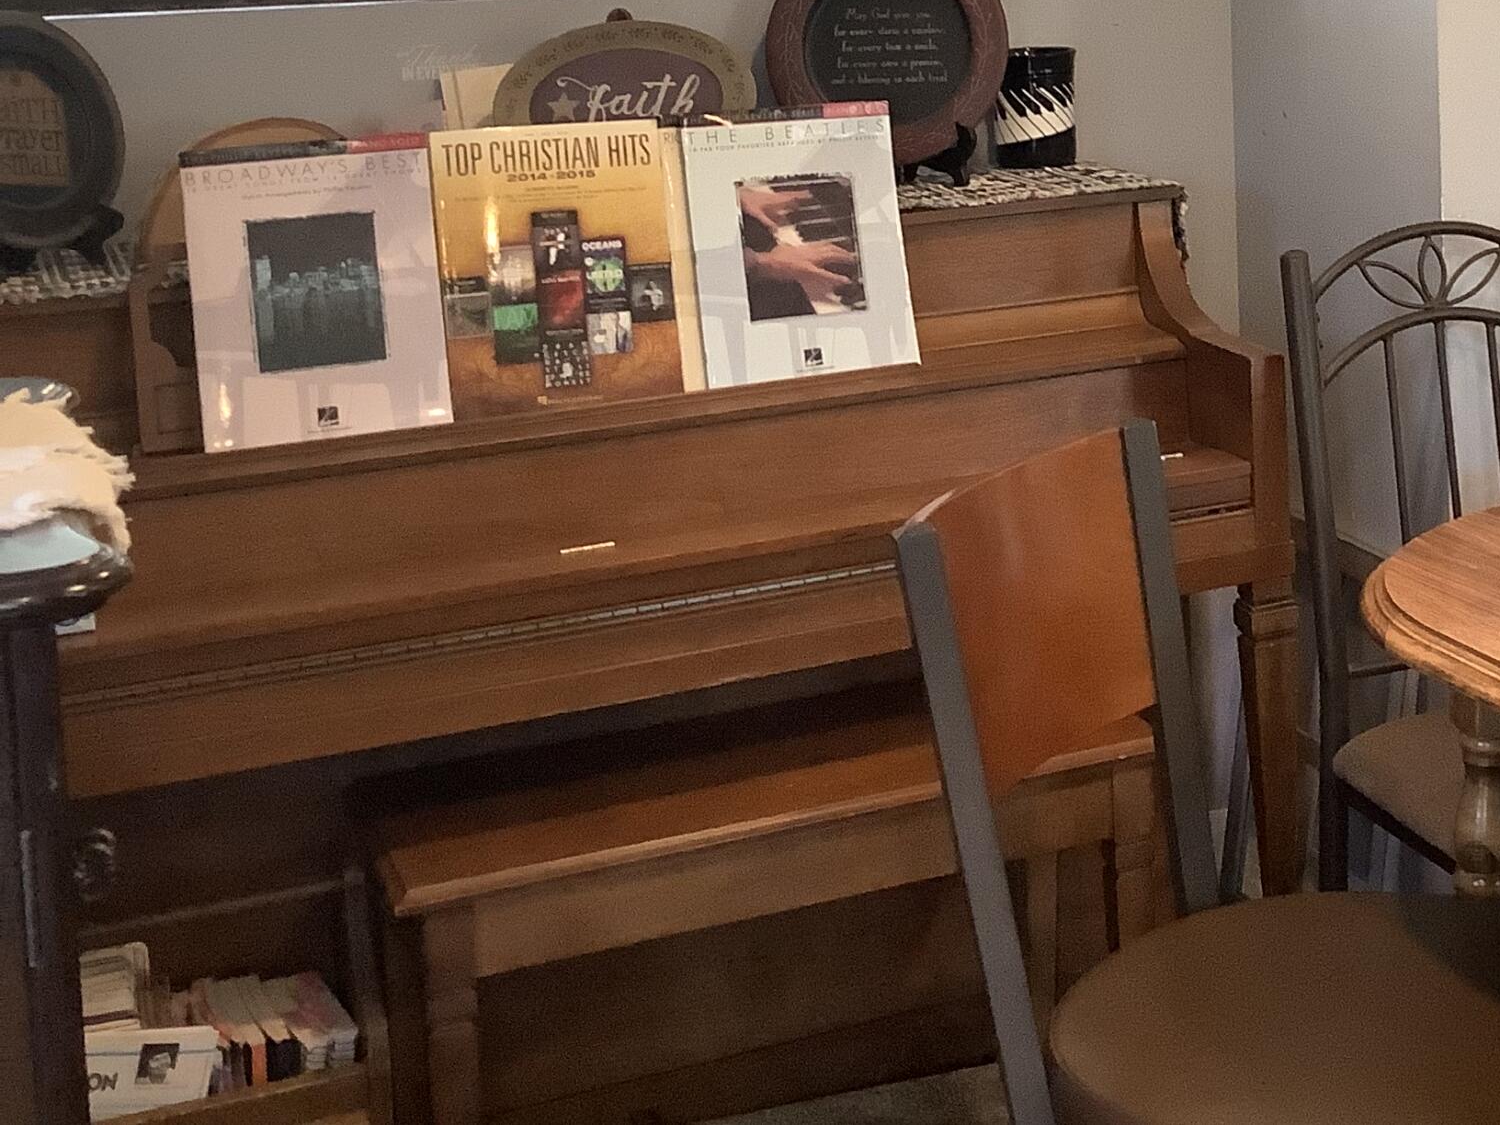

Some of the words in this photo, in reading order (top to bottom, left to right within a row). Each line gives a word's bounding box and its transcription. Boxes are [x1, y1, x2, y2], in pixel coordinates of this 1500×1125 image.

[557, 74, 700, 122] faith
[687, 129, 737, 145] THE
[765, 118, 884, 141] BEATLES
[184, 159, 347, 187] BROADWAY'S
[365, 151, 421, 172] BEST
[441, 141, 482, 177] TOP
[489, 136, 600, 174] CHRISTIAN
[608, 133, 650, 167] HITS
[582, 240, 622, 252] OCEANS
